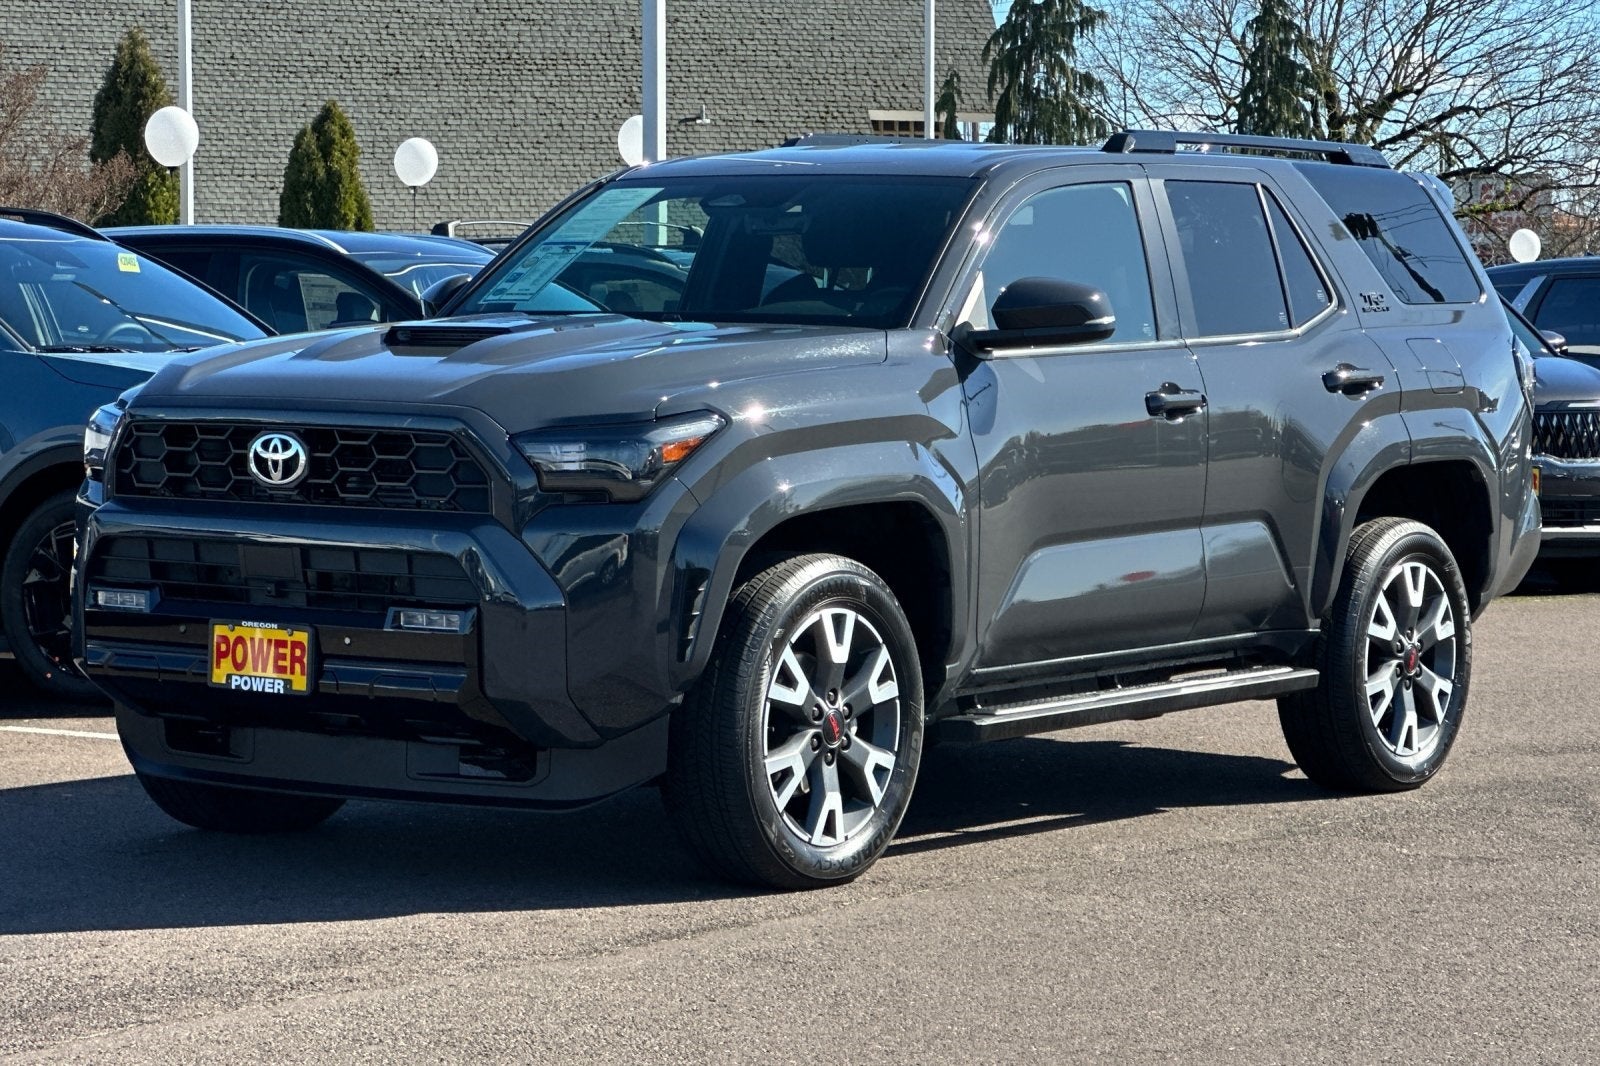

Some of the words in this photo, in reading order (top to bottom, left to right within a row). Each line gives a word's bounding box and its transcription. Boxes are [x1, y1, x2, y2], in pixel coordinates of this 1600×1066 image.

[241, 621, 278, 629] OREGON
[215, 634, 307, 676] POWER
[231, 675, 284, 694] POWER
